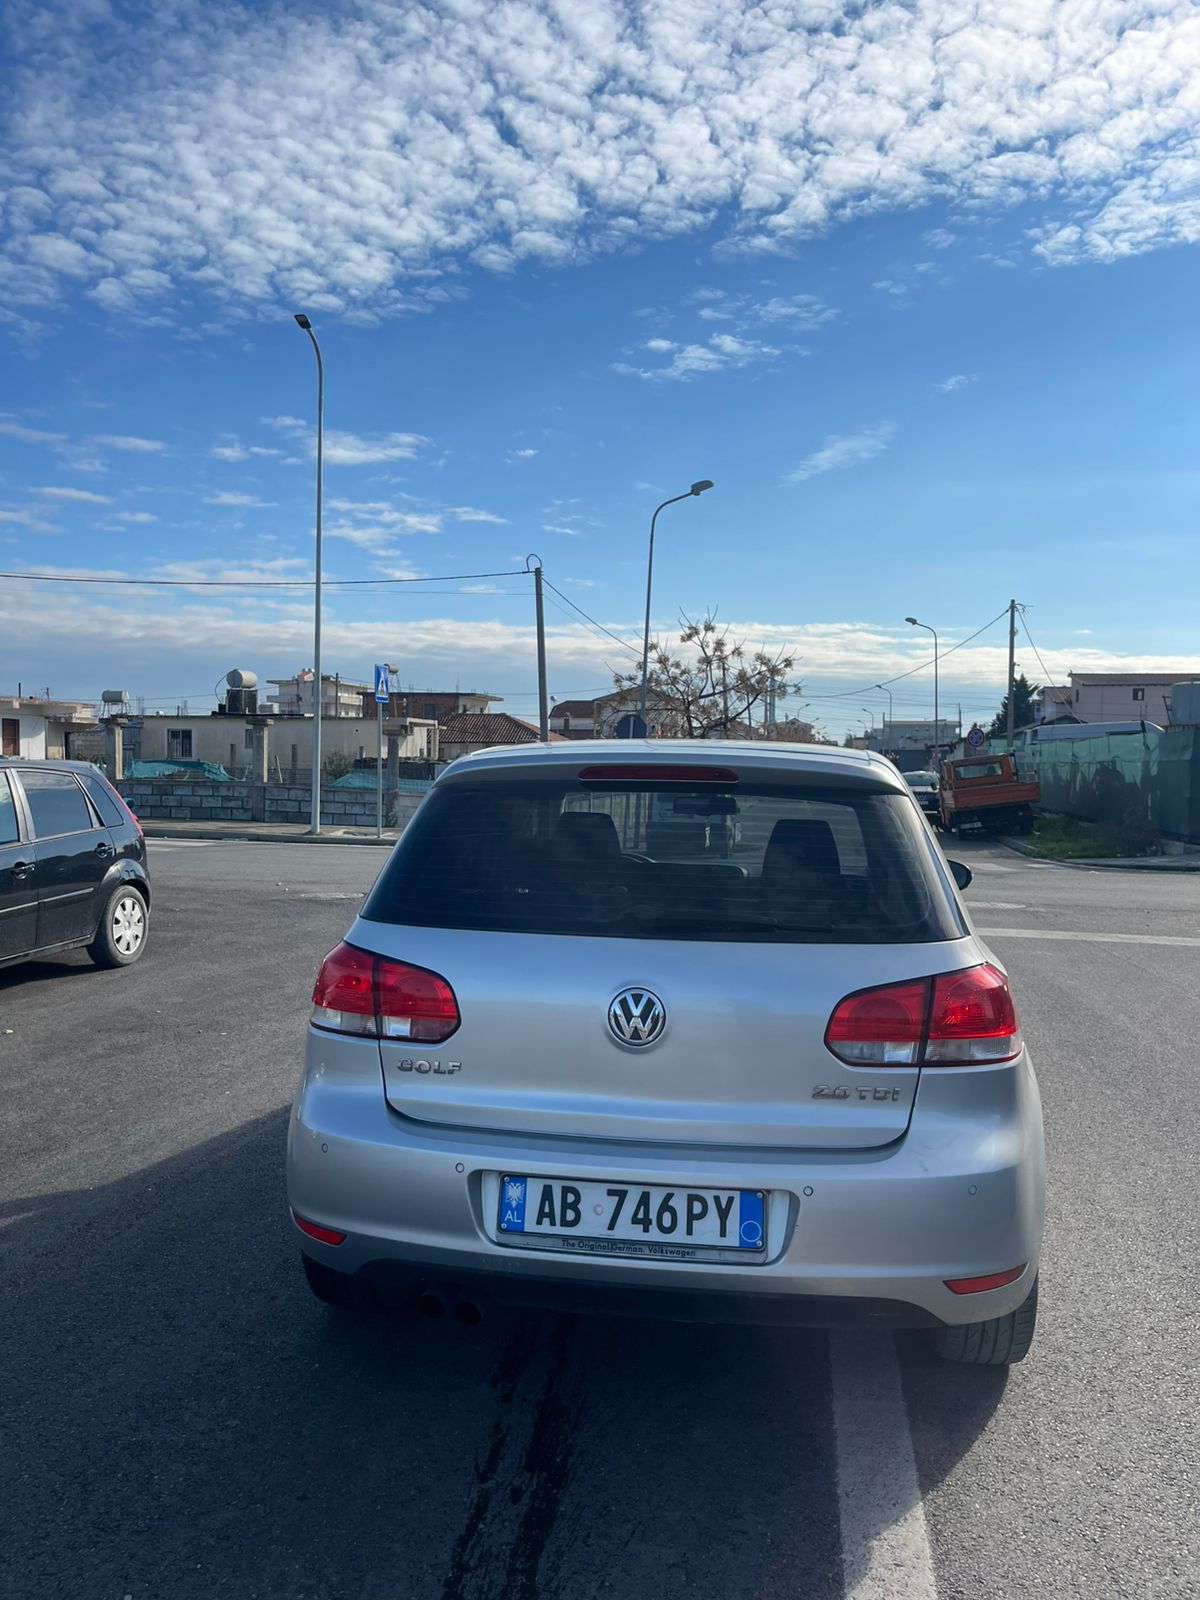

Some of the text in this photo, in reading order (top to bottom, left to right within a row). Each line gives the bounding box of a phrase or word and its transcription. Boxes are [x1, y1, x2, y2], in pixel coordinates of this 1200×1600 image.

[610, 989, 664, 1043] VW
[398, 1058, 462, 1075] GOLF
[856, 1086, 901, 1101] TDI
[504, 1210, 522, 1222] AL
[536, 1184, 735, 1238] AB 746PY
[561, 1239, 576, 1248] The
[648, 1245, 696, 1257] Volkswagen
